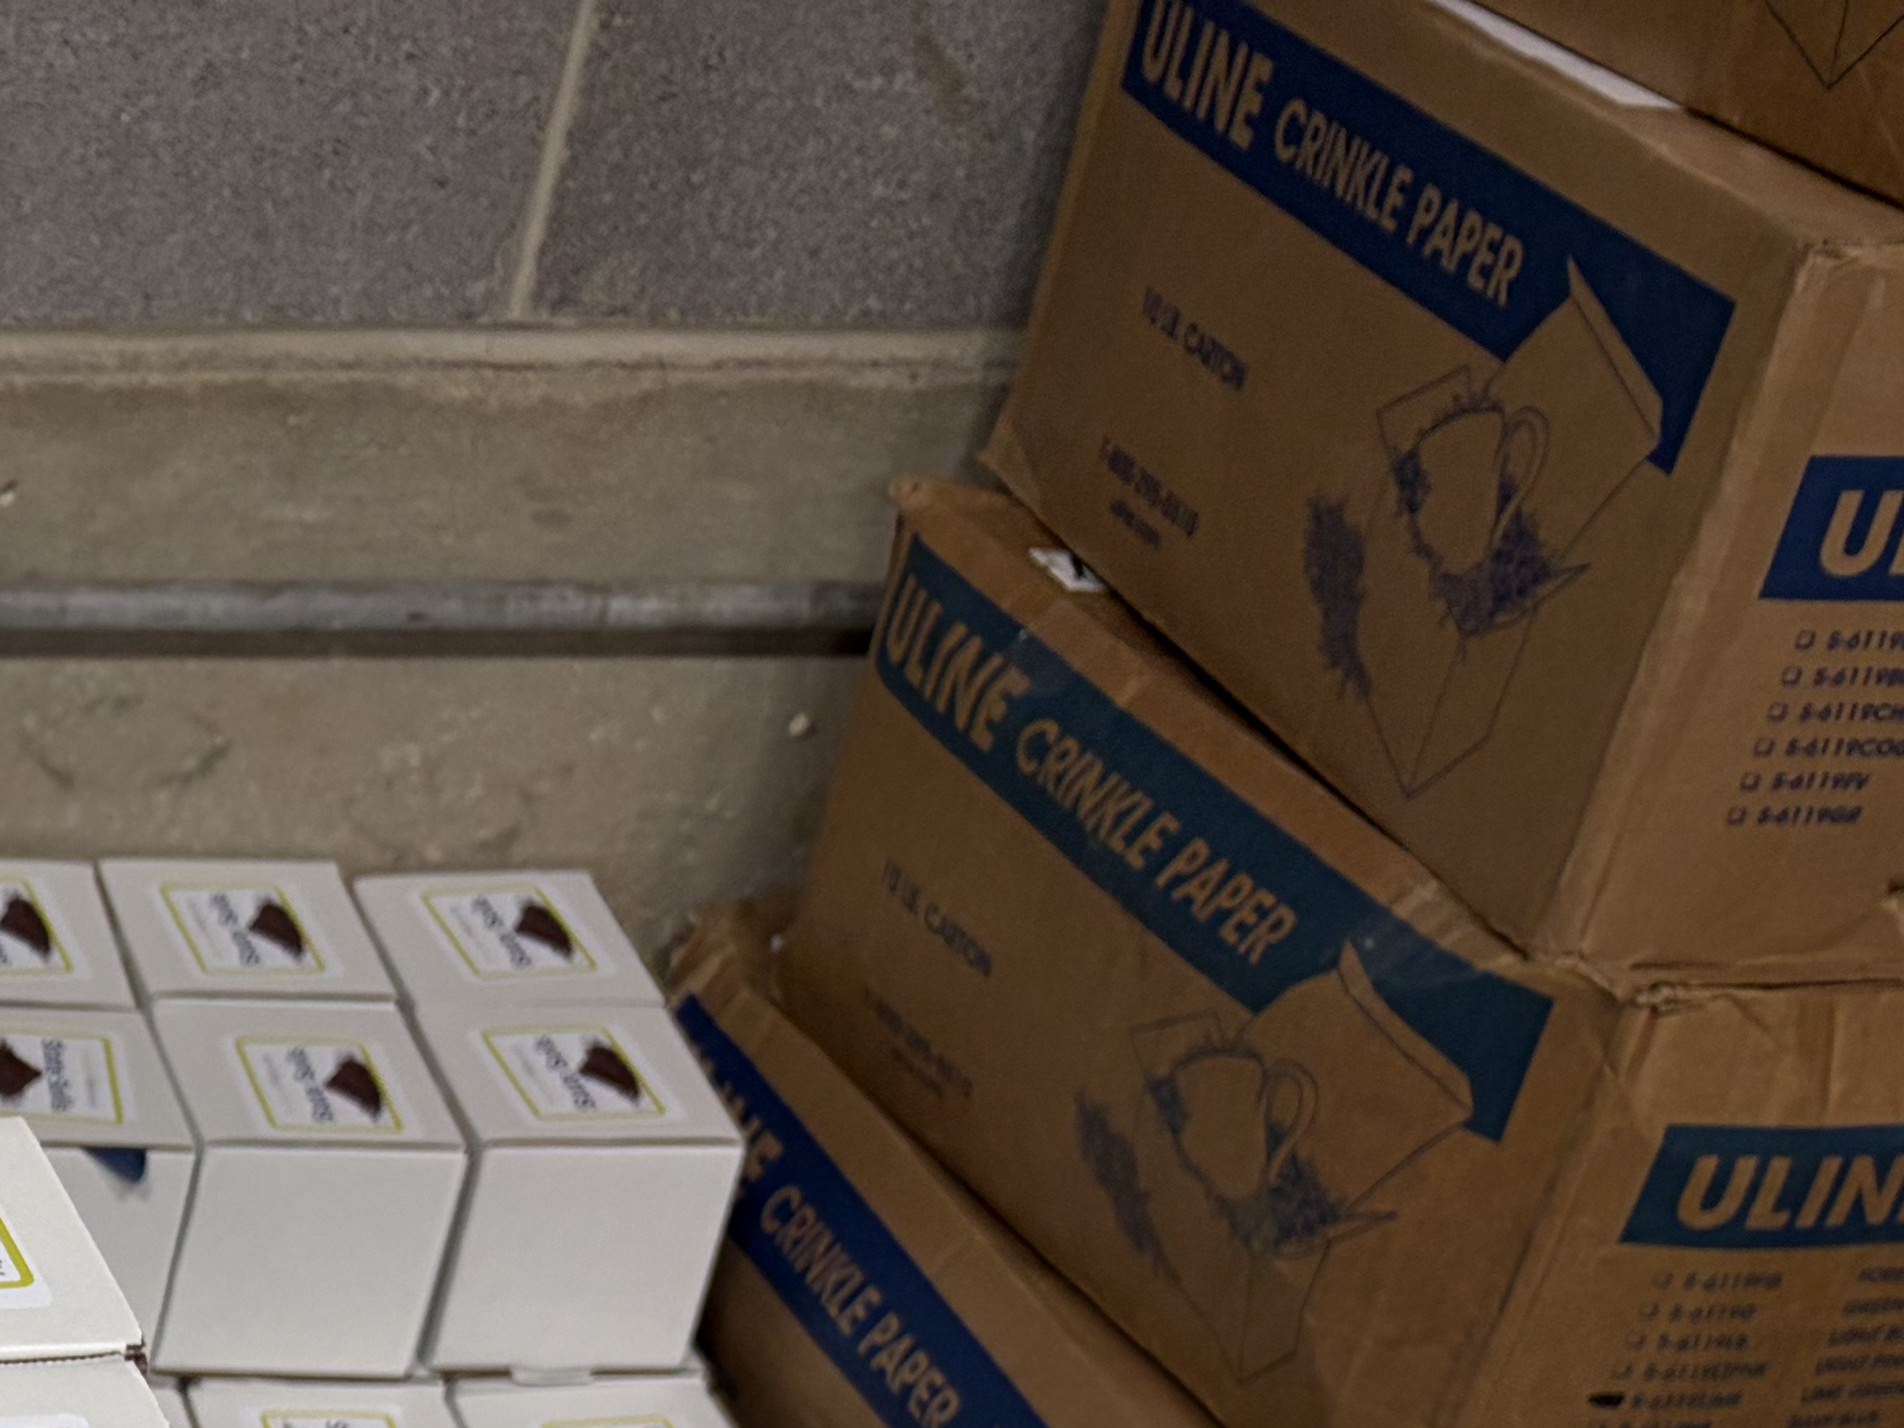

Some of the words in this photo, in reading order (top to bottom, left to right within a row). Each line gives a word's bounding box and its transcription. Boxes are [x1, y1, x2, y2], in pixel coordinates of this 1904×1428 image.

[1141, 0, 1275, 150] ULINE
[1274, 97, 1413, 235] CRINKLE
[1406, 182, 1523, 308] PAPER
[886, 573, 1031, 753] ULINE
[1015, 717, 1183, 871] CRINKLE
[1155, 837, 1298, 966] PAPER
[759, 1183, 883, 1337] CRINKLE
[1676, 1153, 1904, 1232] ULIN
